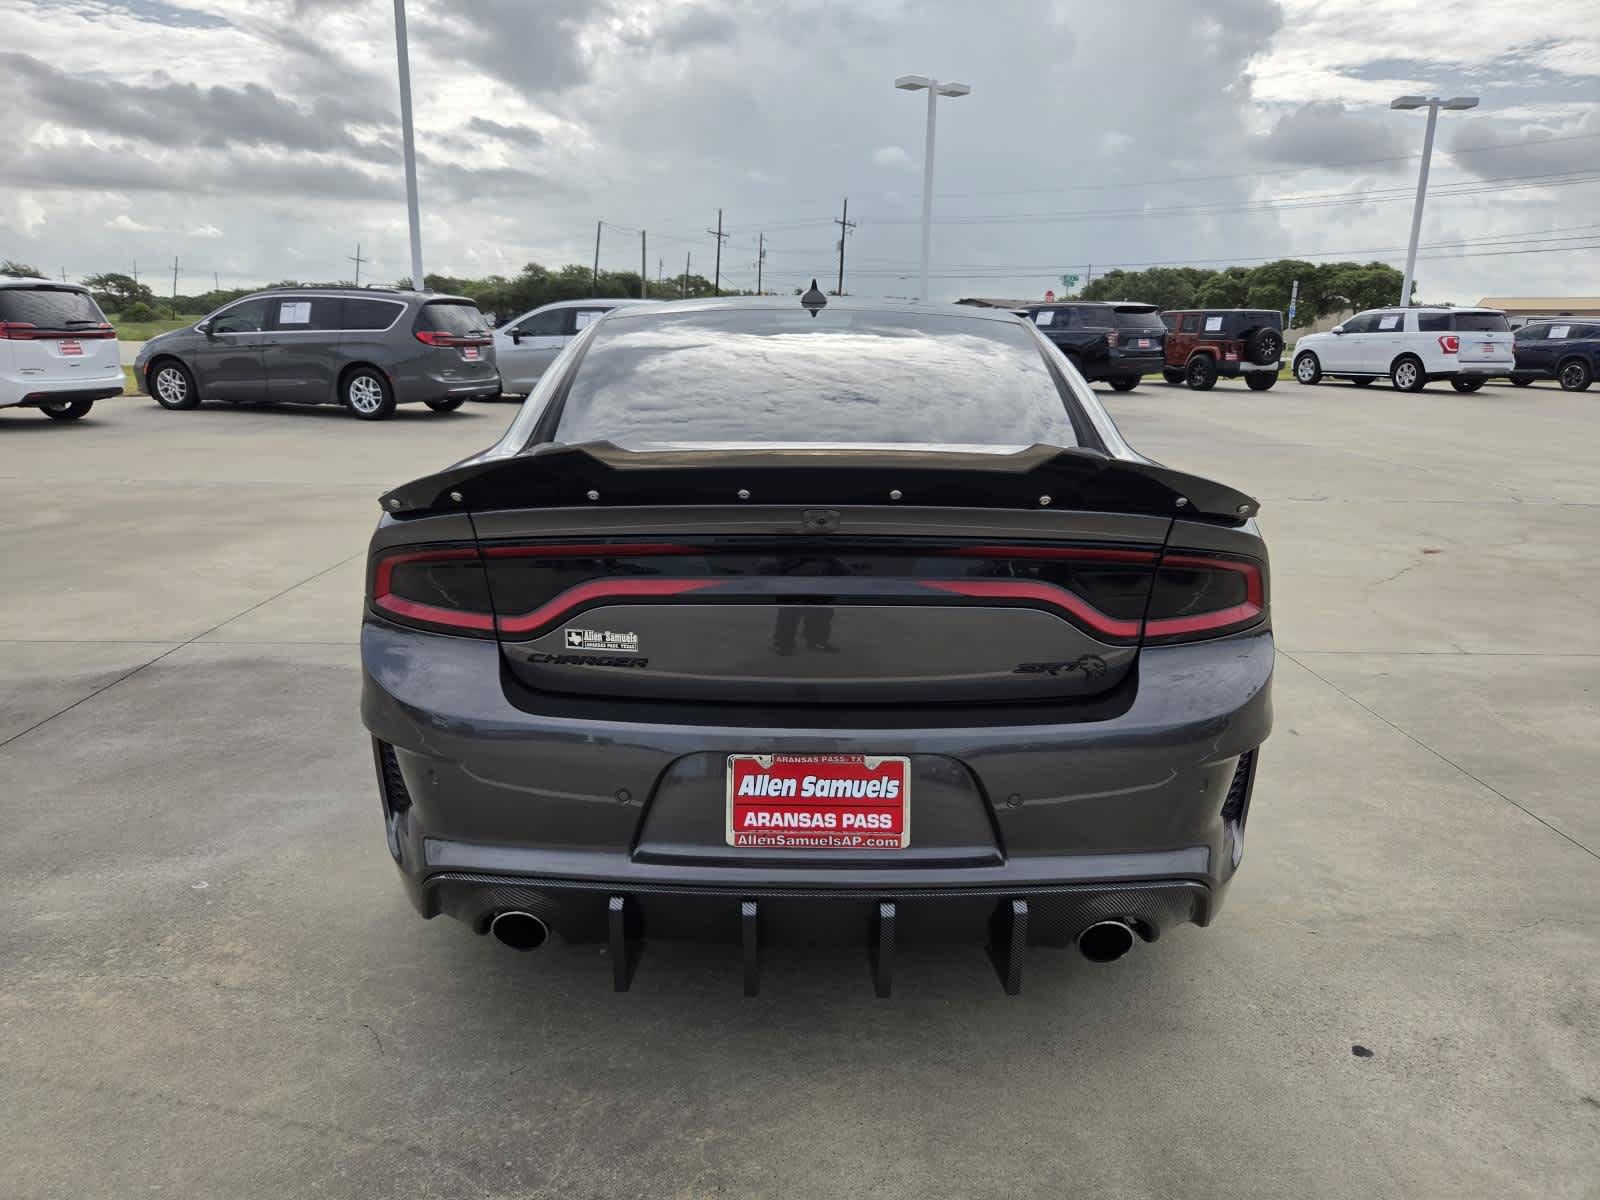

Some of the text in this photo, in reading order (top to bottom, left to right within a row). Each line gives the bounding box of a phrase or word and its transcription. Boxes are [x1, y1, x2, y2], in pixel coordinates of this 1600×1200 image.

[584, 629, 638, 643] Allen Samuels
[527, 653, 649, 668] CHARGER
[738, 775, 900, 799] Allen Samuels
[743, 812, 893, 829] ARANSAS PASS
[738, 835, 899, 847] AllenSamuelsAP.com
